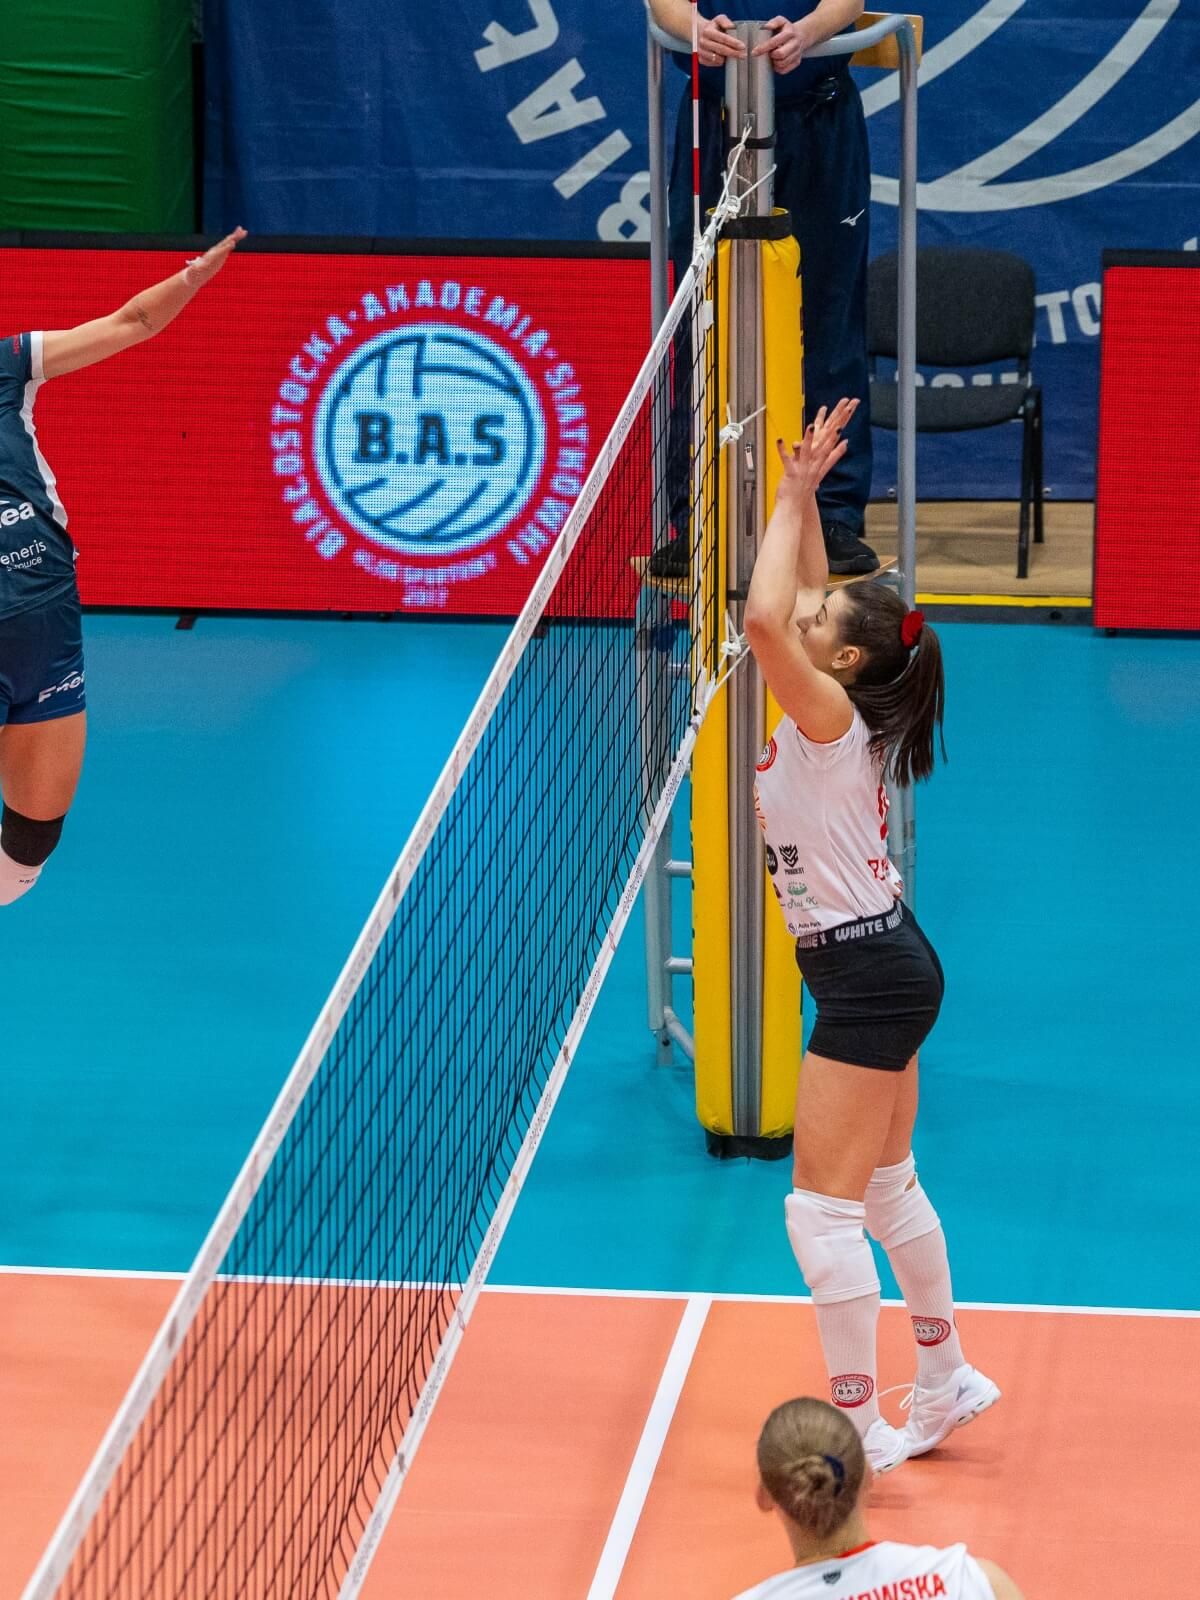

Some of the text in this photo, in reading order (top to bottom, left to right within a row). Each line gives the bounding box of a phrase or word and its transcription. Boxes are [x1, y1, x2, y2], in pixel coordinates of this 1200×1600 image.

[354, 412, 507, 466] B.A.S
[0, 539, 47, 566] eneris
[835, 919, 884, 942] WHITE
